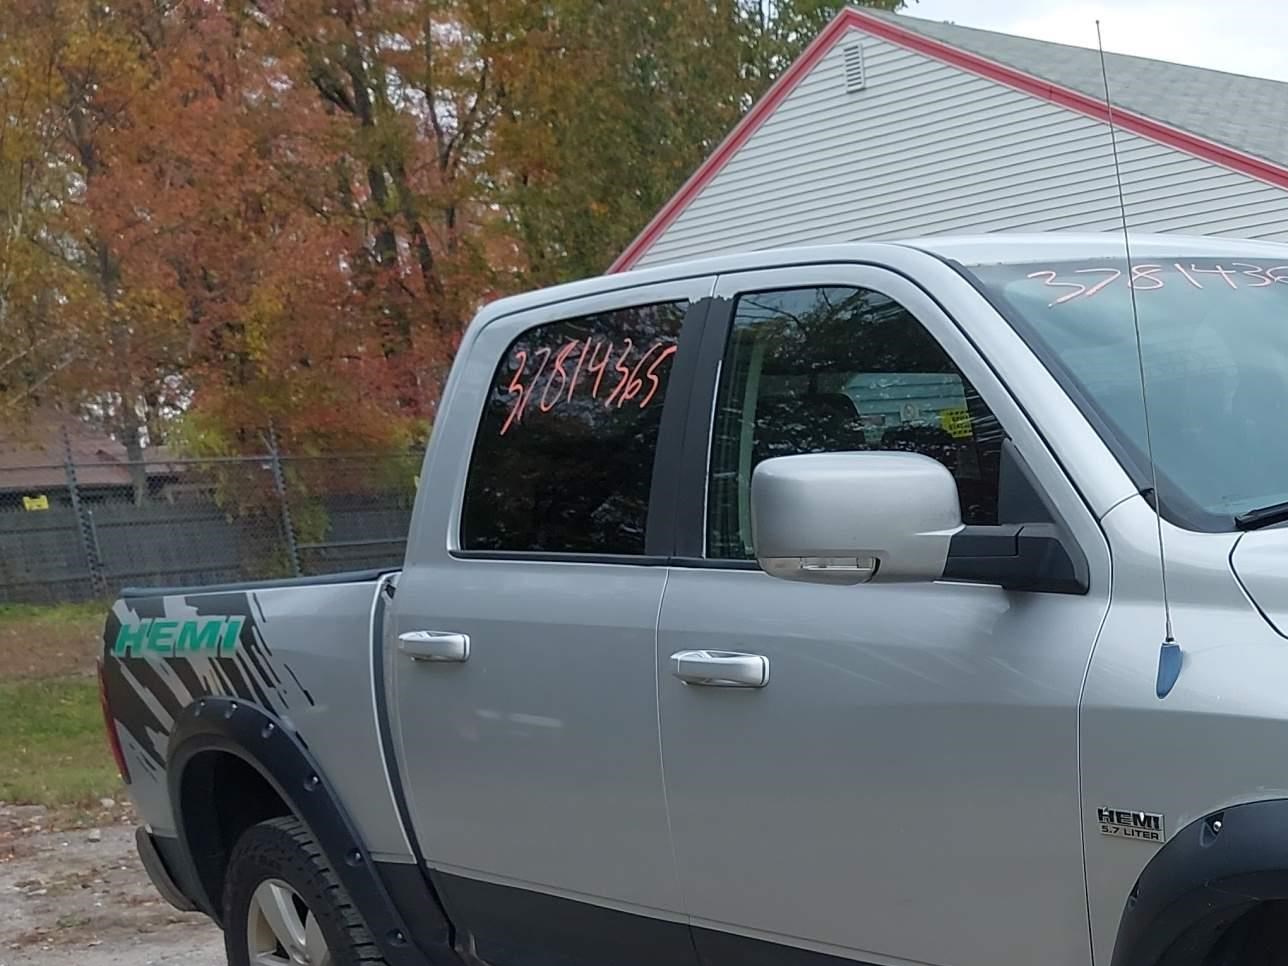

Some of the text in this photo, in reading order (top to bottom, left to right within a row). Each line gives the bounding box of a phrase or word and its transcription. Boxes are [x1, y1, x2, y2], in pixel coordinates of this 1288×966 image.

[501, 336, 677, 435] 37814365
[116, 618, 244, 656] HEMI
[1097, 808, 1160, 830] HEMI
[1101, 825, 1159, 840] 5.7 LITER
